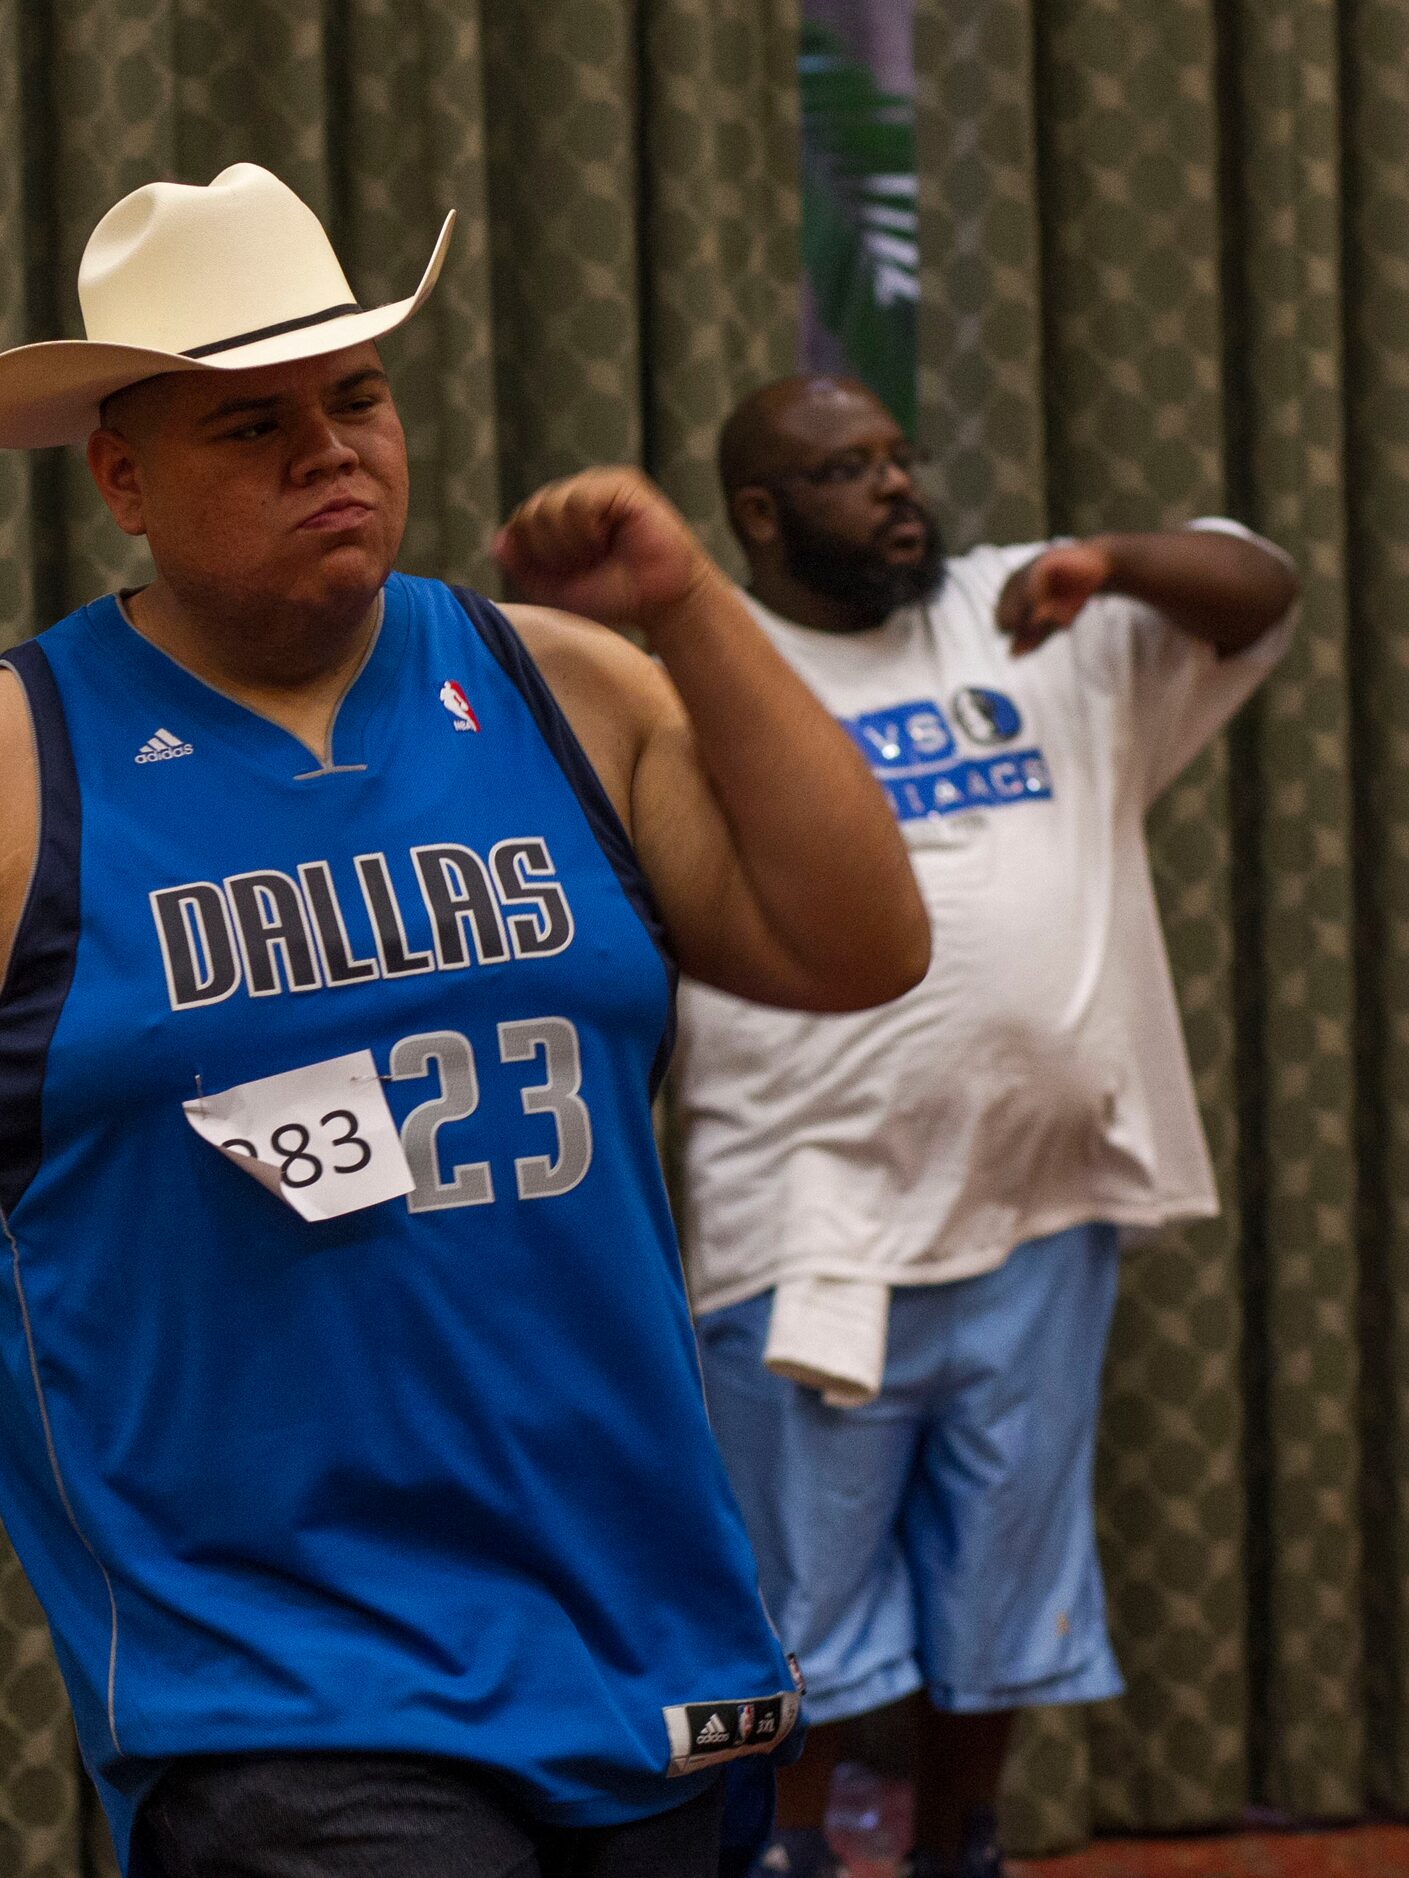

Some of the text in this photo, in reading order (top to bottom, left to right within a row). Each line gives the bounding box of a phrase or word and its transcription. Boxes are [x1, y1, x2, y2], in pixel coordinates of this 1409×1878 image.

[134, 743, 194, 764] adidas
[149, 836, 575, 1012] DALLAS
[389, 1016, 592, 1213] 23
